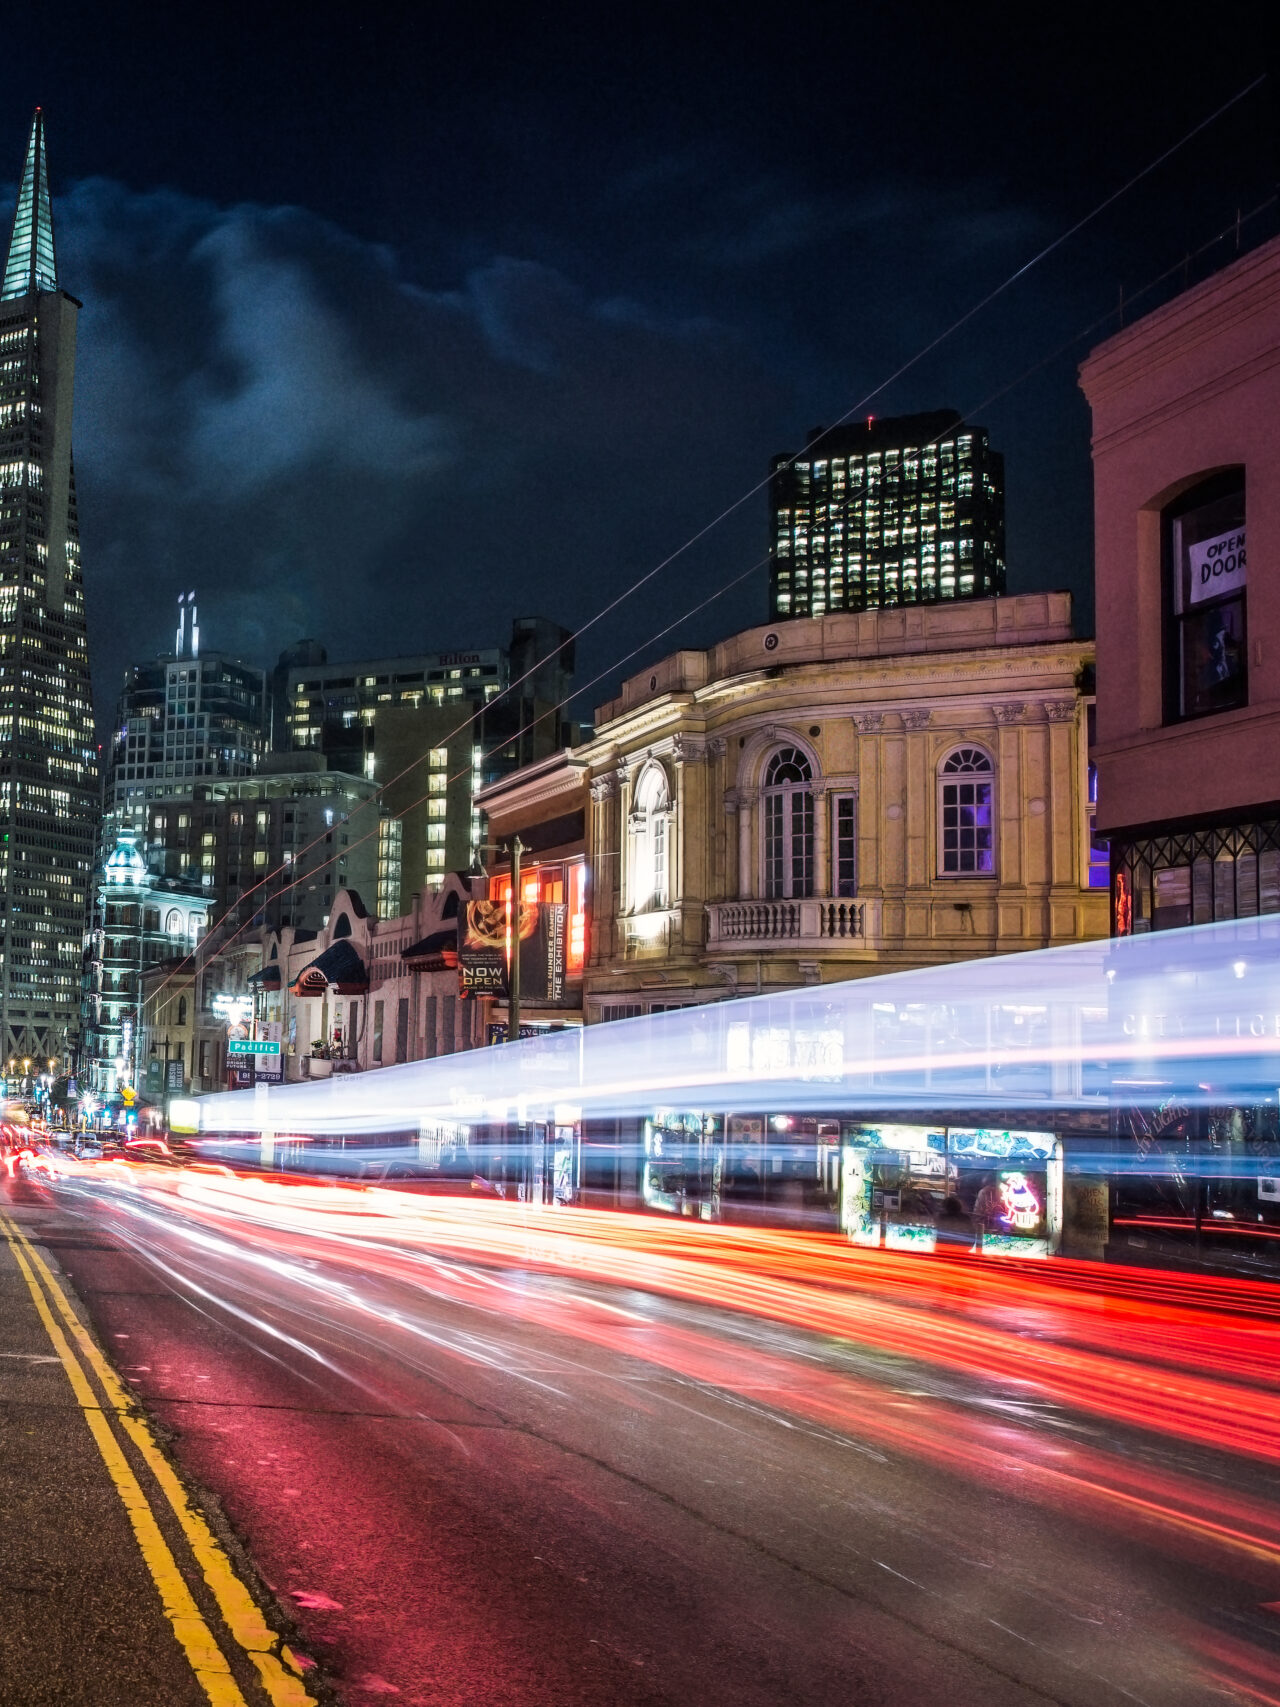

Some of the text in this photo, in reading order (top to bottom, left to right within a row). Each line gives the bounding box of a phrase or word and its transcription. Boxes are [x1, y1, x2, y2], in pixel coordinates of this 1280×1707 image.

[1207, 533, 1246, 558] OPEN
[1201, 549, 1247, 584] DOOR
[439, 652, 480, 666] Hilton
[554, 905, 565, 1000] THE EXHIBITION
[462, 967, 503, 977] NOW
[463, 977, 503, 985] OPEN
[234, 1043, 275, 1052] Pacific
[168, 1062, 176, 1088] BABSON
[176, 1063, 184, 1088] COLLEGE
[1152, 1104, 1191, 1134] LIGHTS
